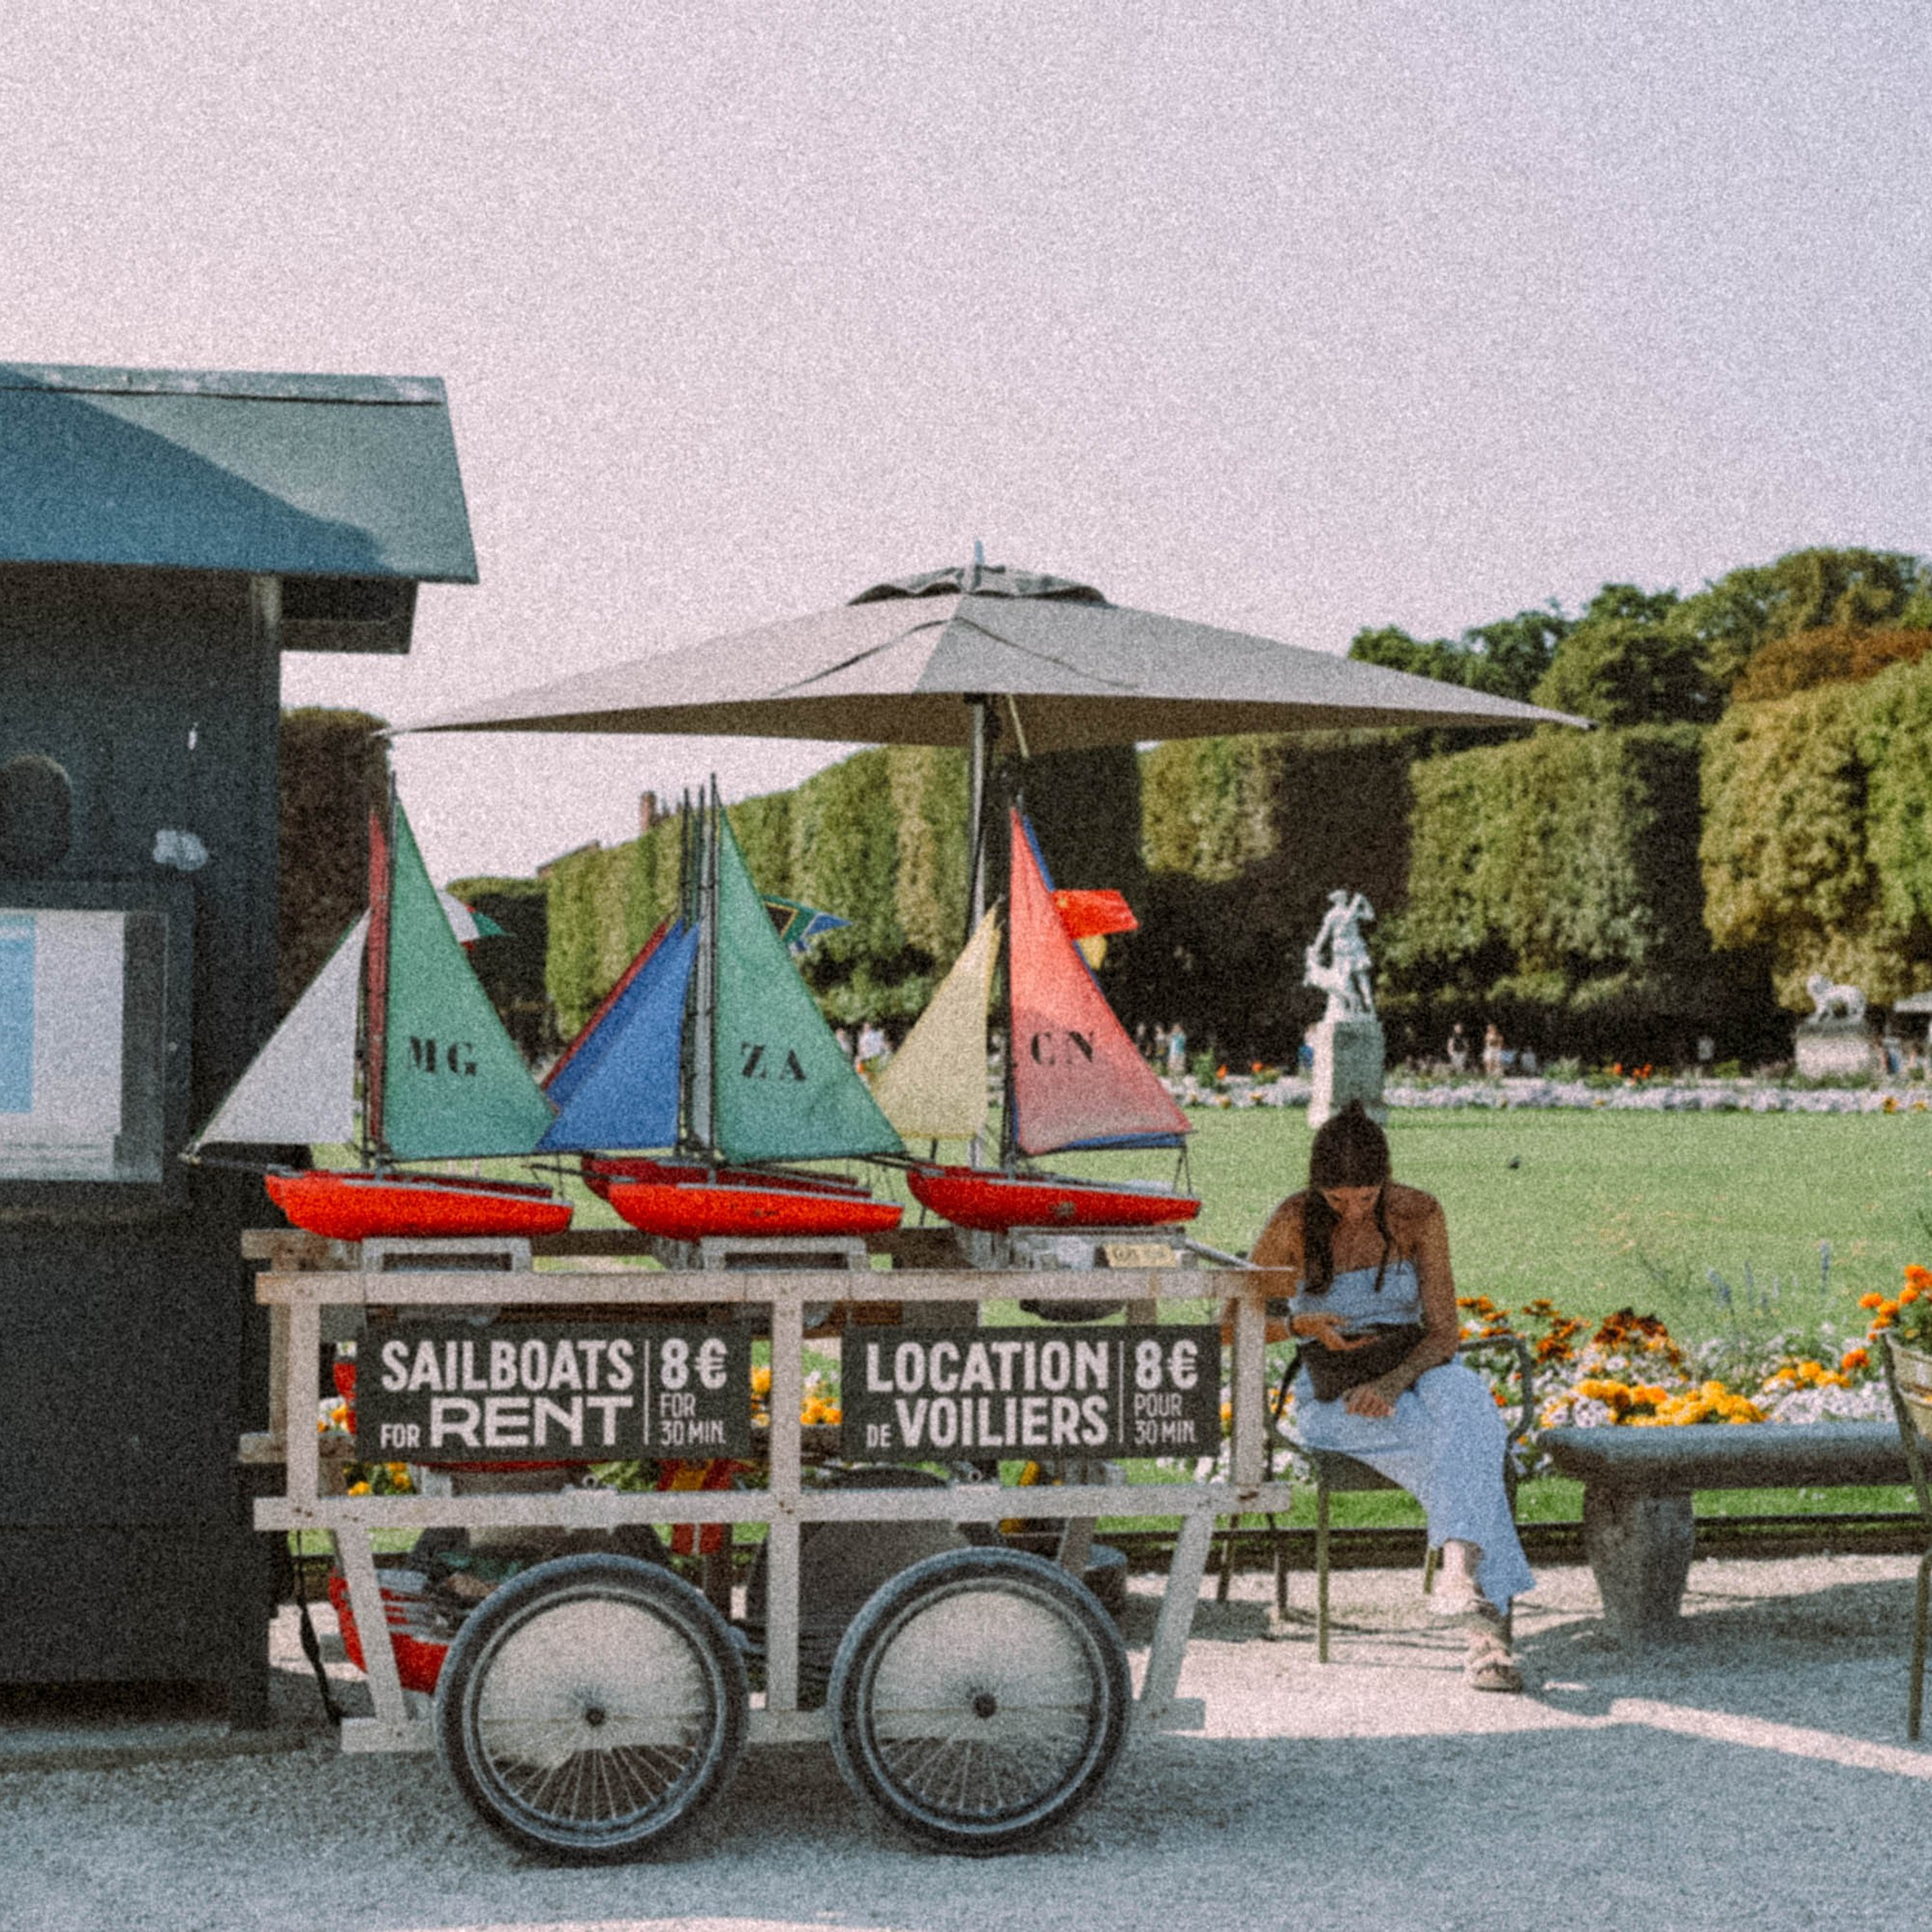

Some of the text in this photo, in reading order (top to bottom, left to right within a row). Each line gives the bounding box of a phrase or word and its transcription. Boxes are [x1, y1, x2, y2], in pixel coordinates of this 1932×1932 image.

[408, 1035, 477, 1076] MG
[741, 1041, 807, 1081] ZA
[1030, 1030, 1094, 1065] CN
[380, 1339, 635, 1392] SAILBOATS
[866, 1340, 1109, 1392] LOCATION
[380, 1395, 634, 1449] FOR RENT
[660, 1393, 696, 1418] FOR
[866, 1395, 1109, 1448] DE VOILIERS
[1134, 1392, 1183, 1418] POUR
[660, 1420, 685, 1446] 30
[1134, 1420, 1158, 1446] 30
